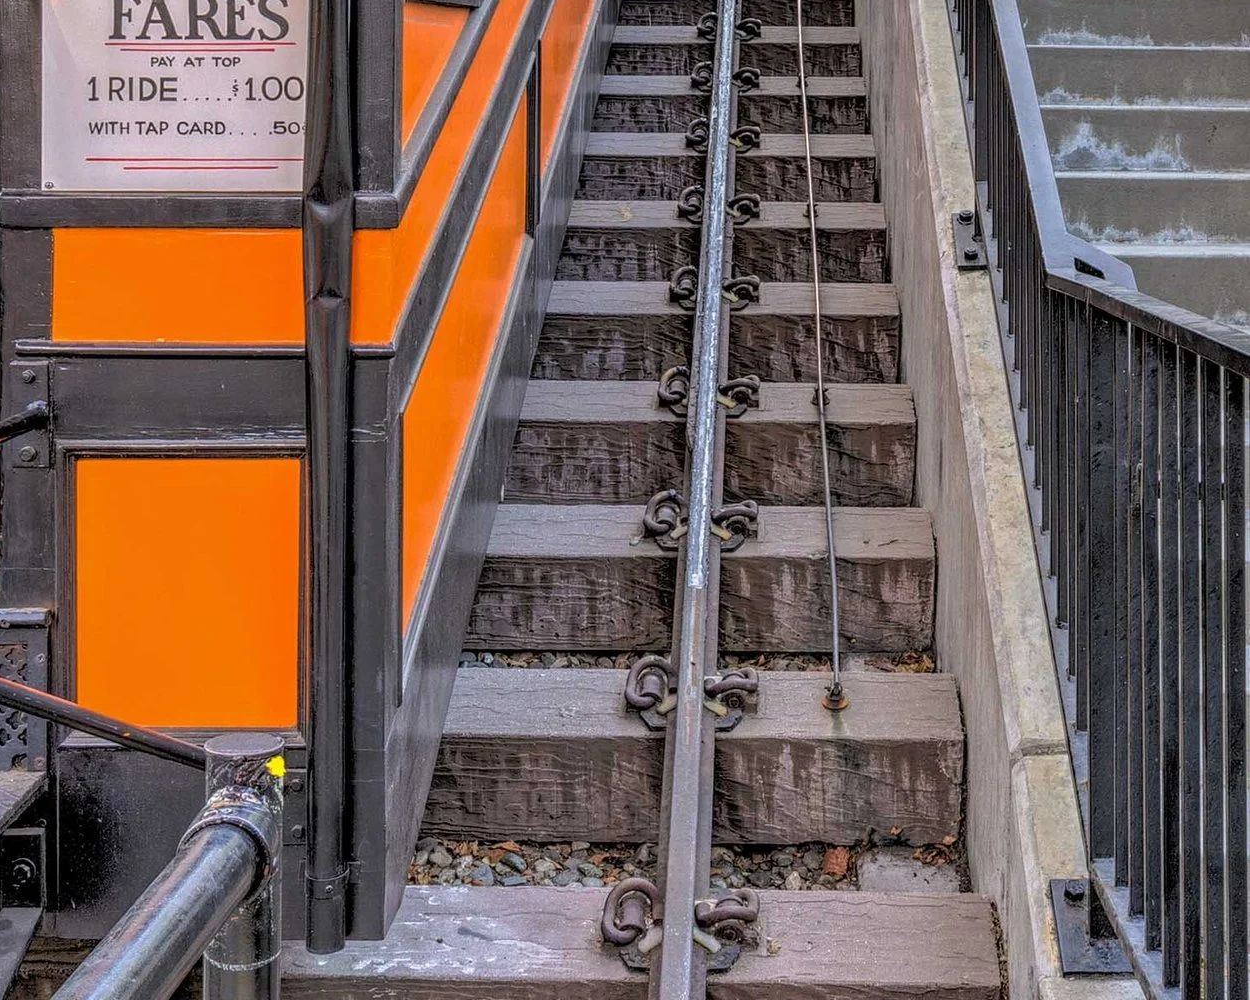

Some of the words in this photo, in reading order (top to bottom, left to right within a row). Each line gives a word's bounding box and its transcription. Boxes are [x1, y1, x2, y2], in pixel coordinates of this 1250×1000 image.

[150, 57, 176, 68] PAY
[183, 57, 205, 67] AT
[212, 57, 241, 68] TOP
[87, 76, 100, 101] 1
[88, 121, 130, 136] WITH
[135, 121, 169, 136] TAP
